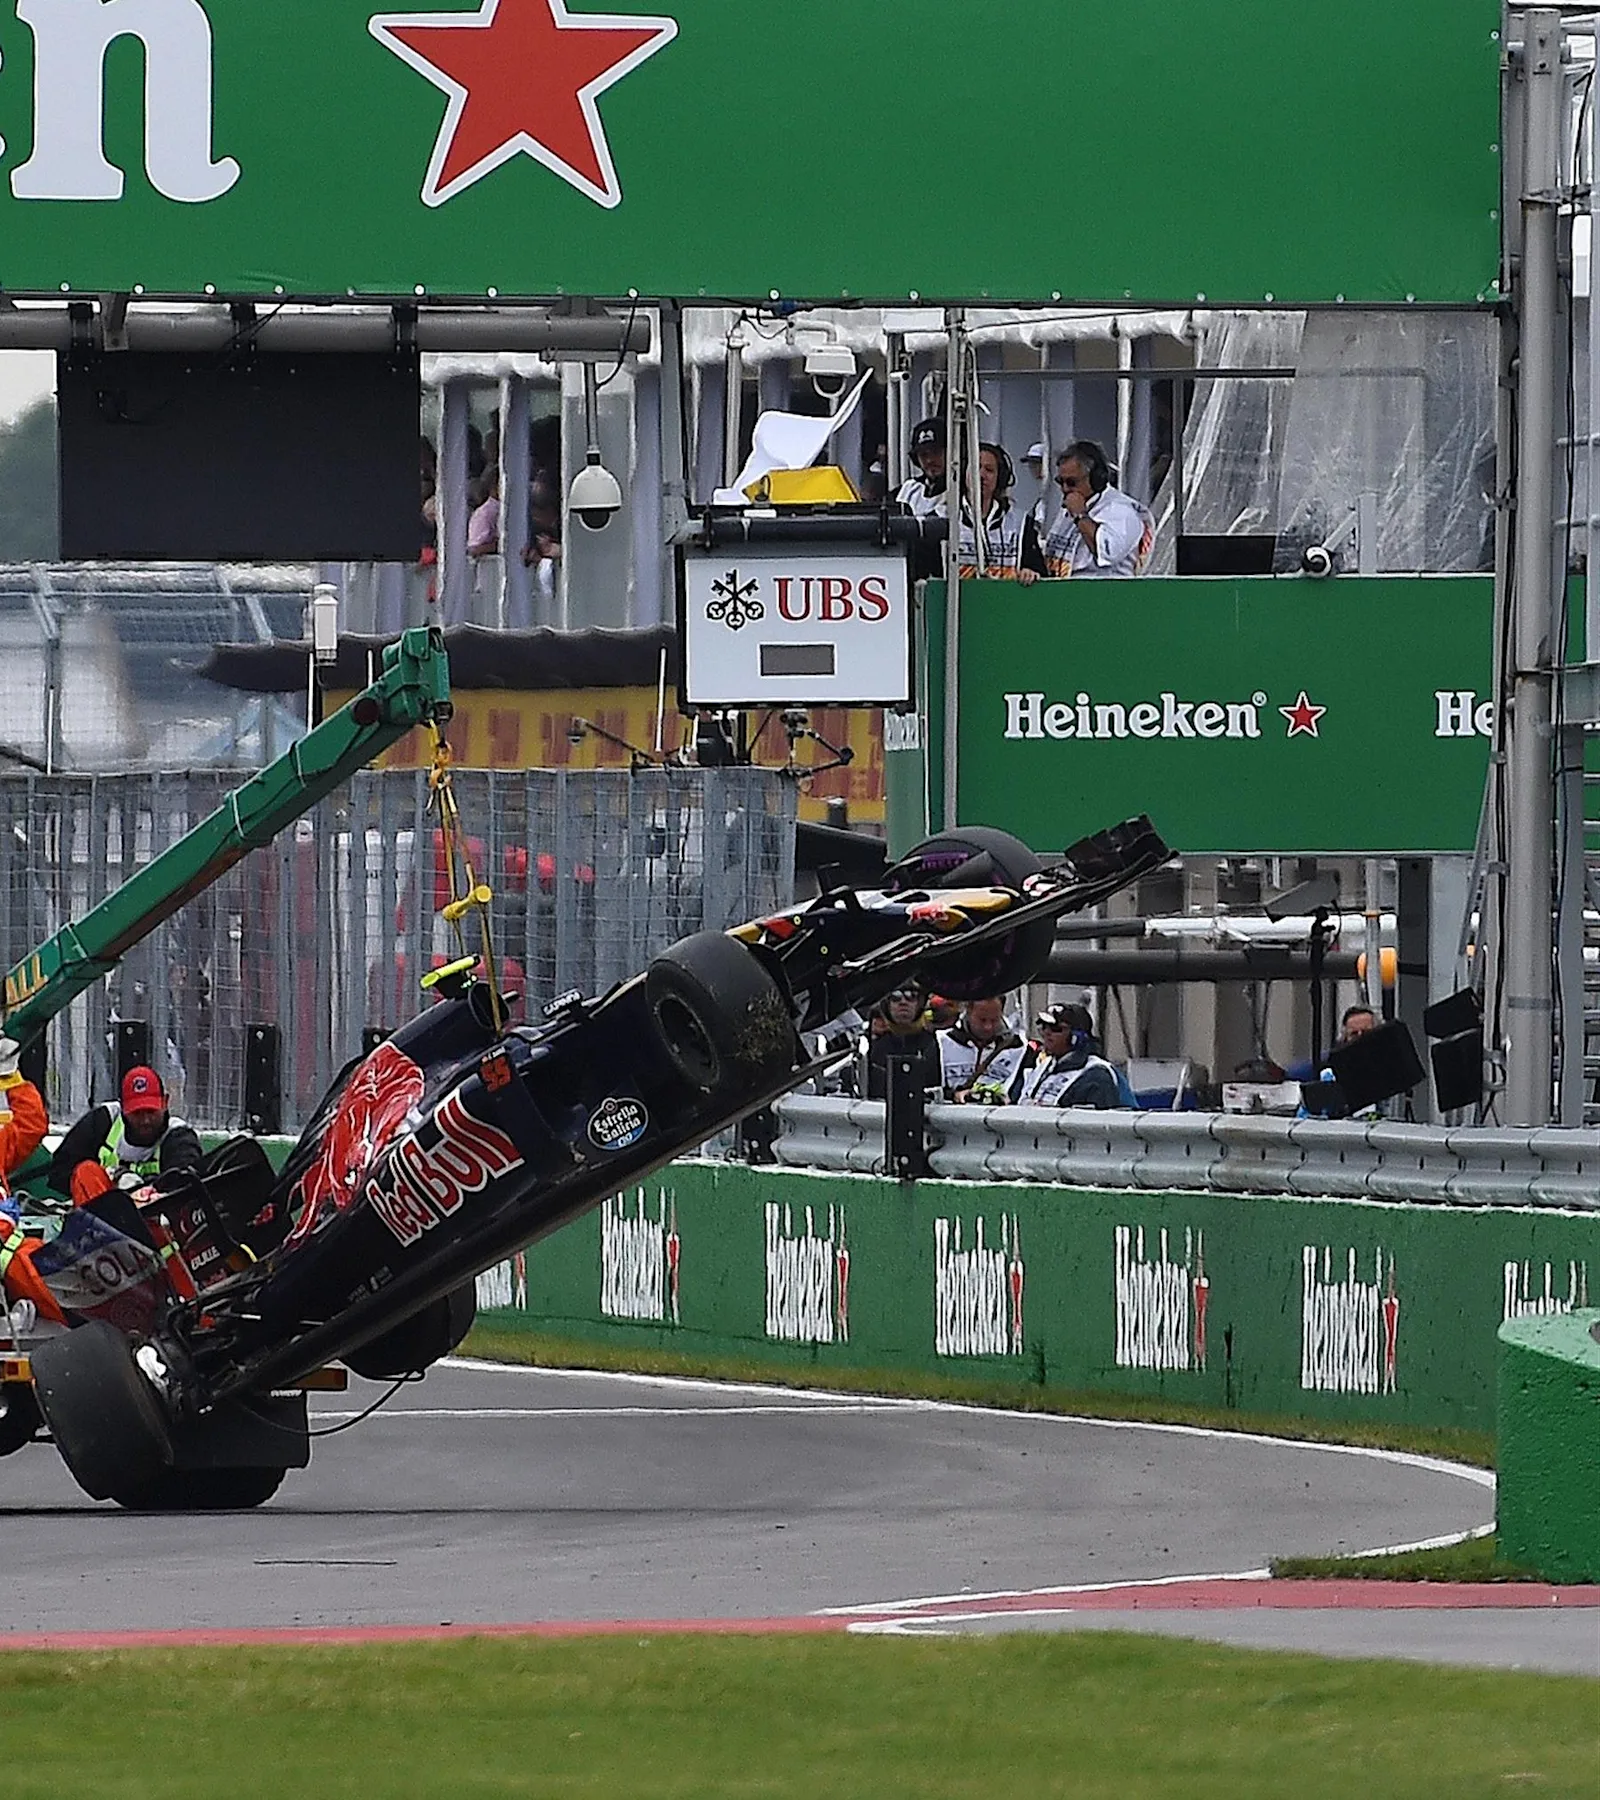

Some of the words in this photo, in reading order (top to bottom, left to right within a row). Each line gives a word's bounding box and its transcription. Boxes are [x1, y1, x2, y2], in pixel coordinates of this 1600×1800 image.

[773, 577, 890, 621] UBS
[480, 1056, 513, 1093] 55
[593, 1102, 638, 1132] Estrella
[600, 1116, 641, 1143] Galicia
[400, 1088, 525, 1218] Bull
[366, 1148, 440, 1248] Red
